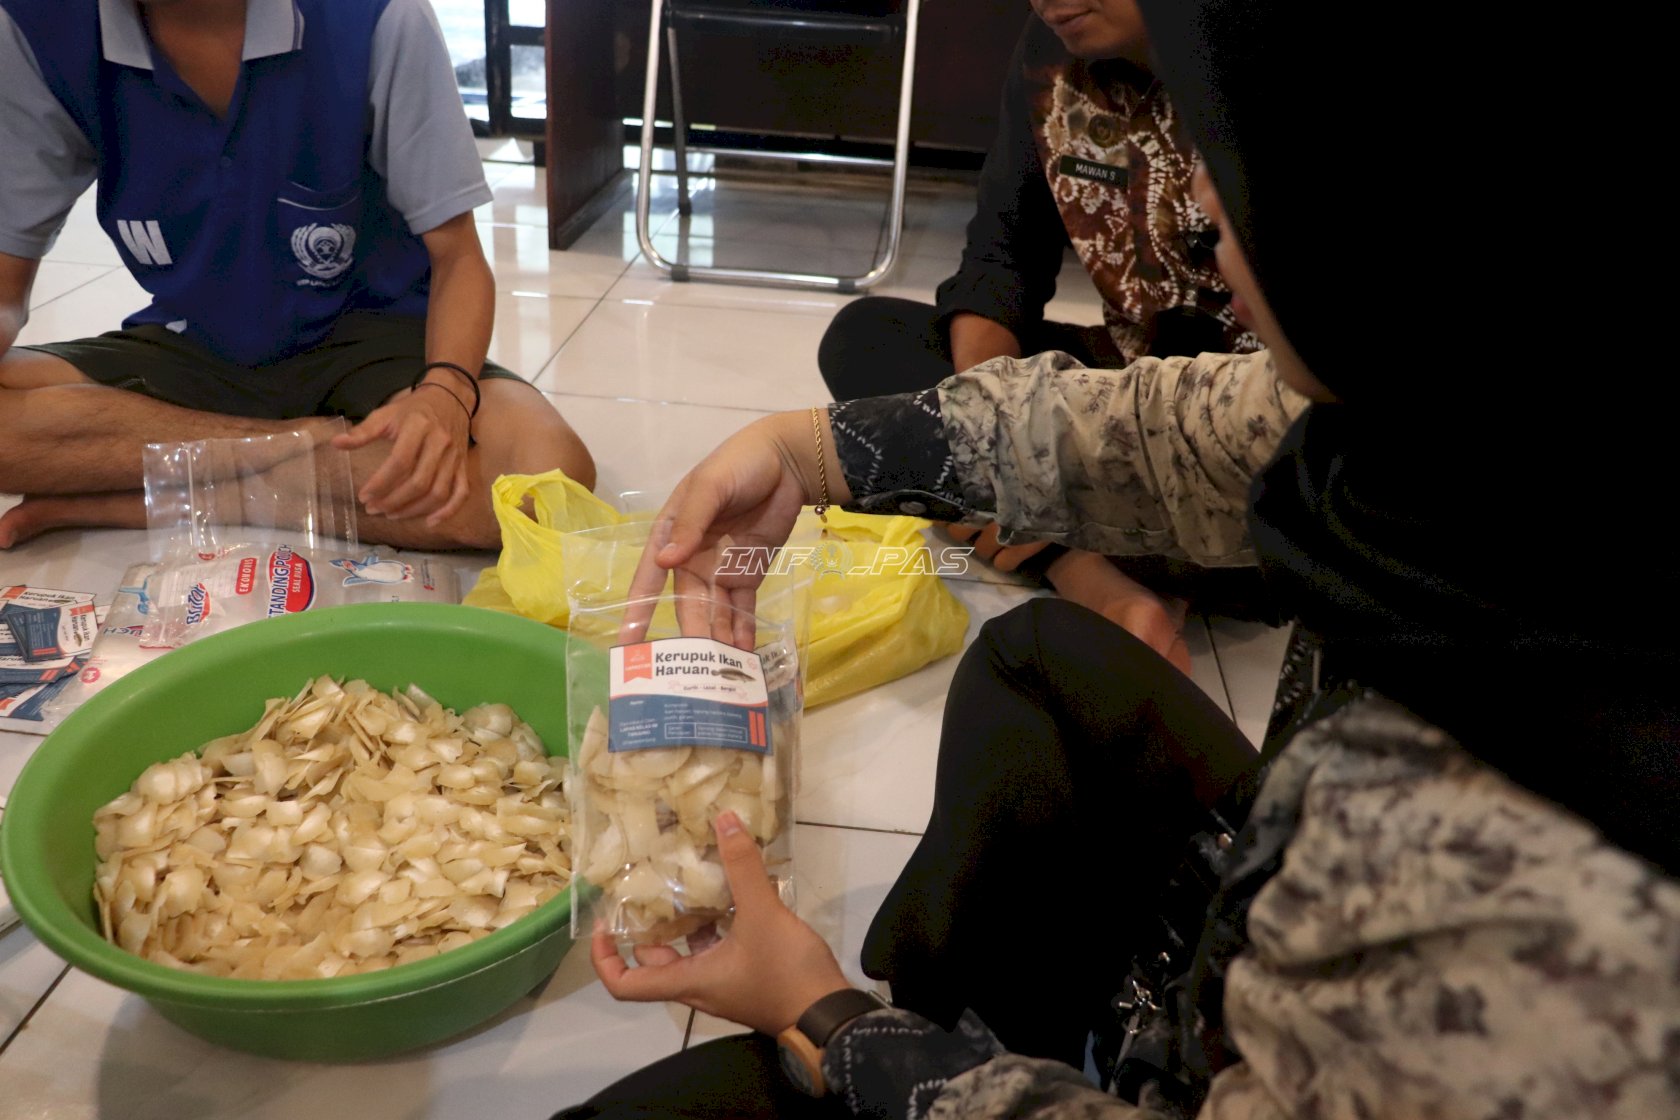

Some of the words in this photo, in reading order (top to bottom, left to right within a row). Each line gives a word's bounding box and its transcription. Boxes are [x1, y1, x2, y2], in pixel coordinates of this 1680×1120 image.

[1075, 163, 1108, 179] MAWAN
[1109, 170, 1116, 180] S
[268, 566, 289, 618] TANDING
[655, 651, 716, 664] Kerupuk
[718, 653, 743, 669] Ikan
[655, 664, 710, 677] Haruan
